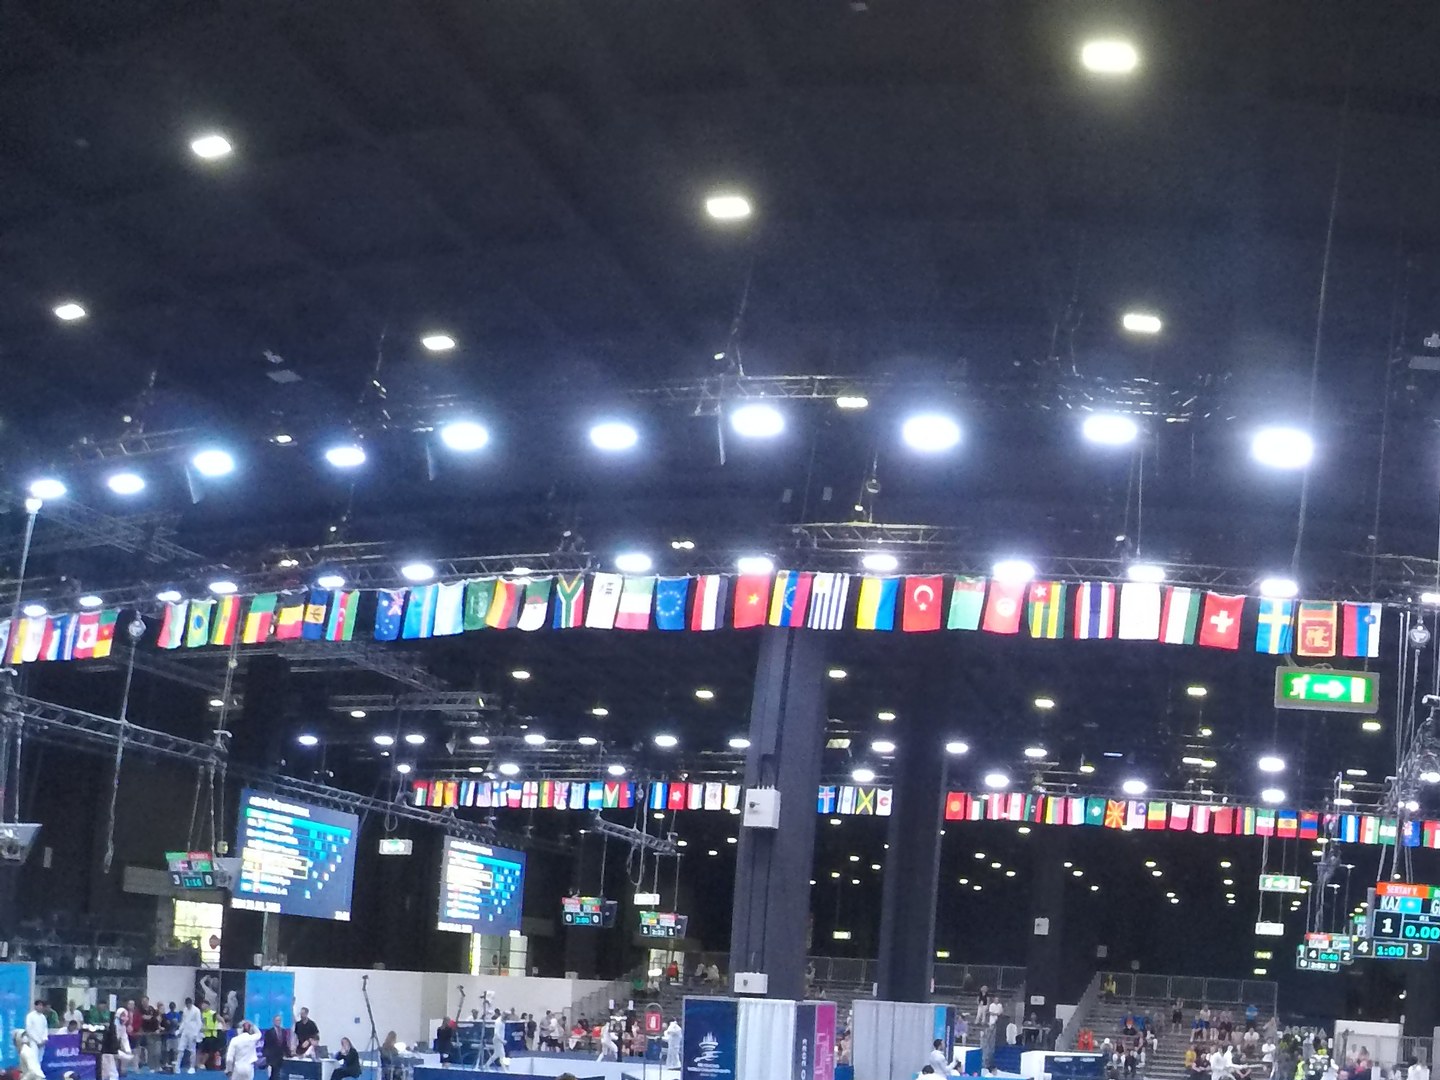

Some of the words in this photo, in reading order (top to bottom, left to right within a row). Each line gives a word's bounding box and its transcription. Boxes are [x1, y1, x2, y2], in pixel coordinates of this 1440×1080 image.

[1381, 895, 1400, 911] KAZ
[1381, 918, 1393, 933] 1
[1405, 925, 1440, 939] 0.00
[1309, 950, 1317, 958] 4
[1342, 952, 1350, 961] 2
[1357, 941, 1369, 953] 4
[1376, 946, 1404, 956] 1:00
[1411, 943, 1423, 955] 3
